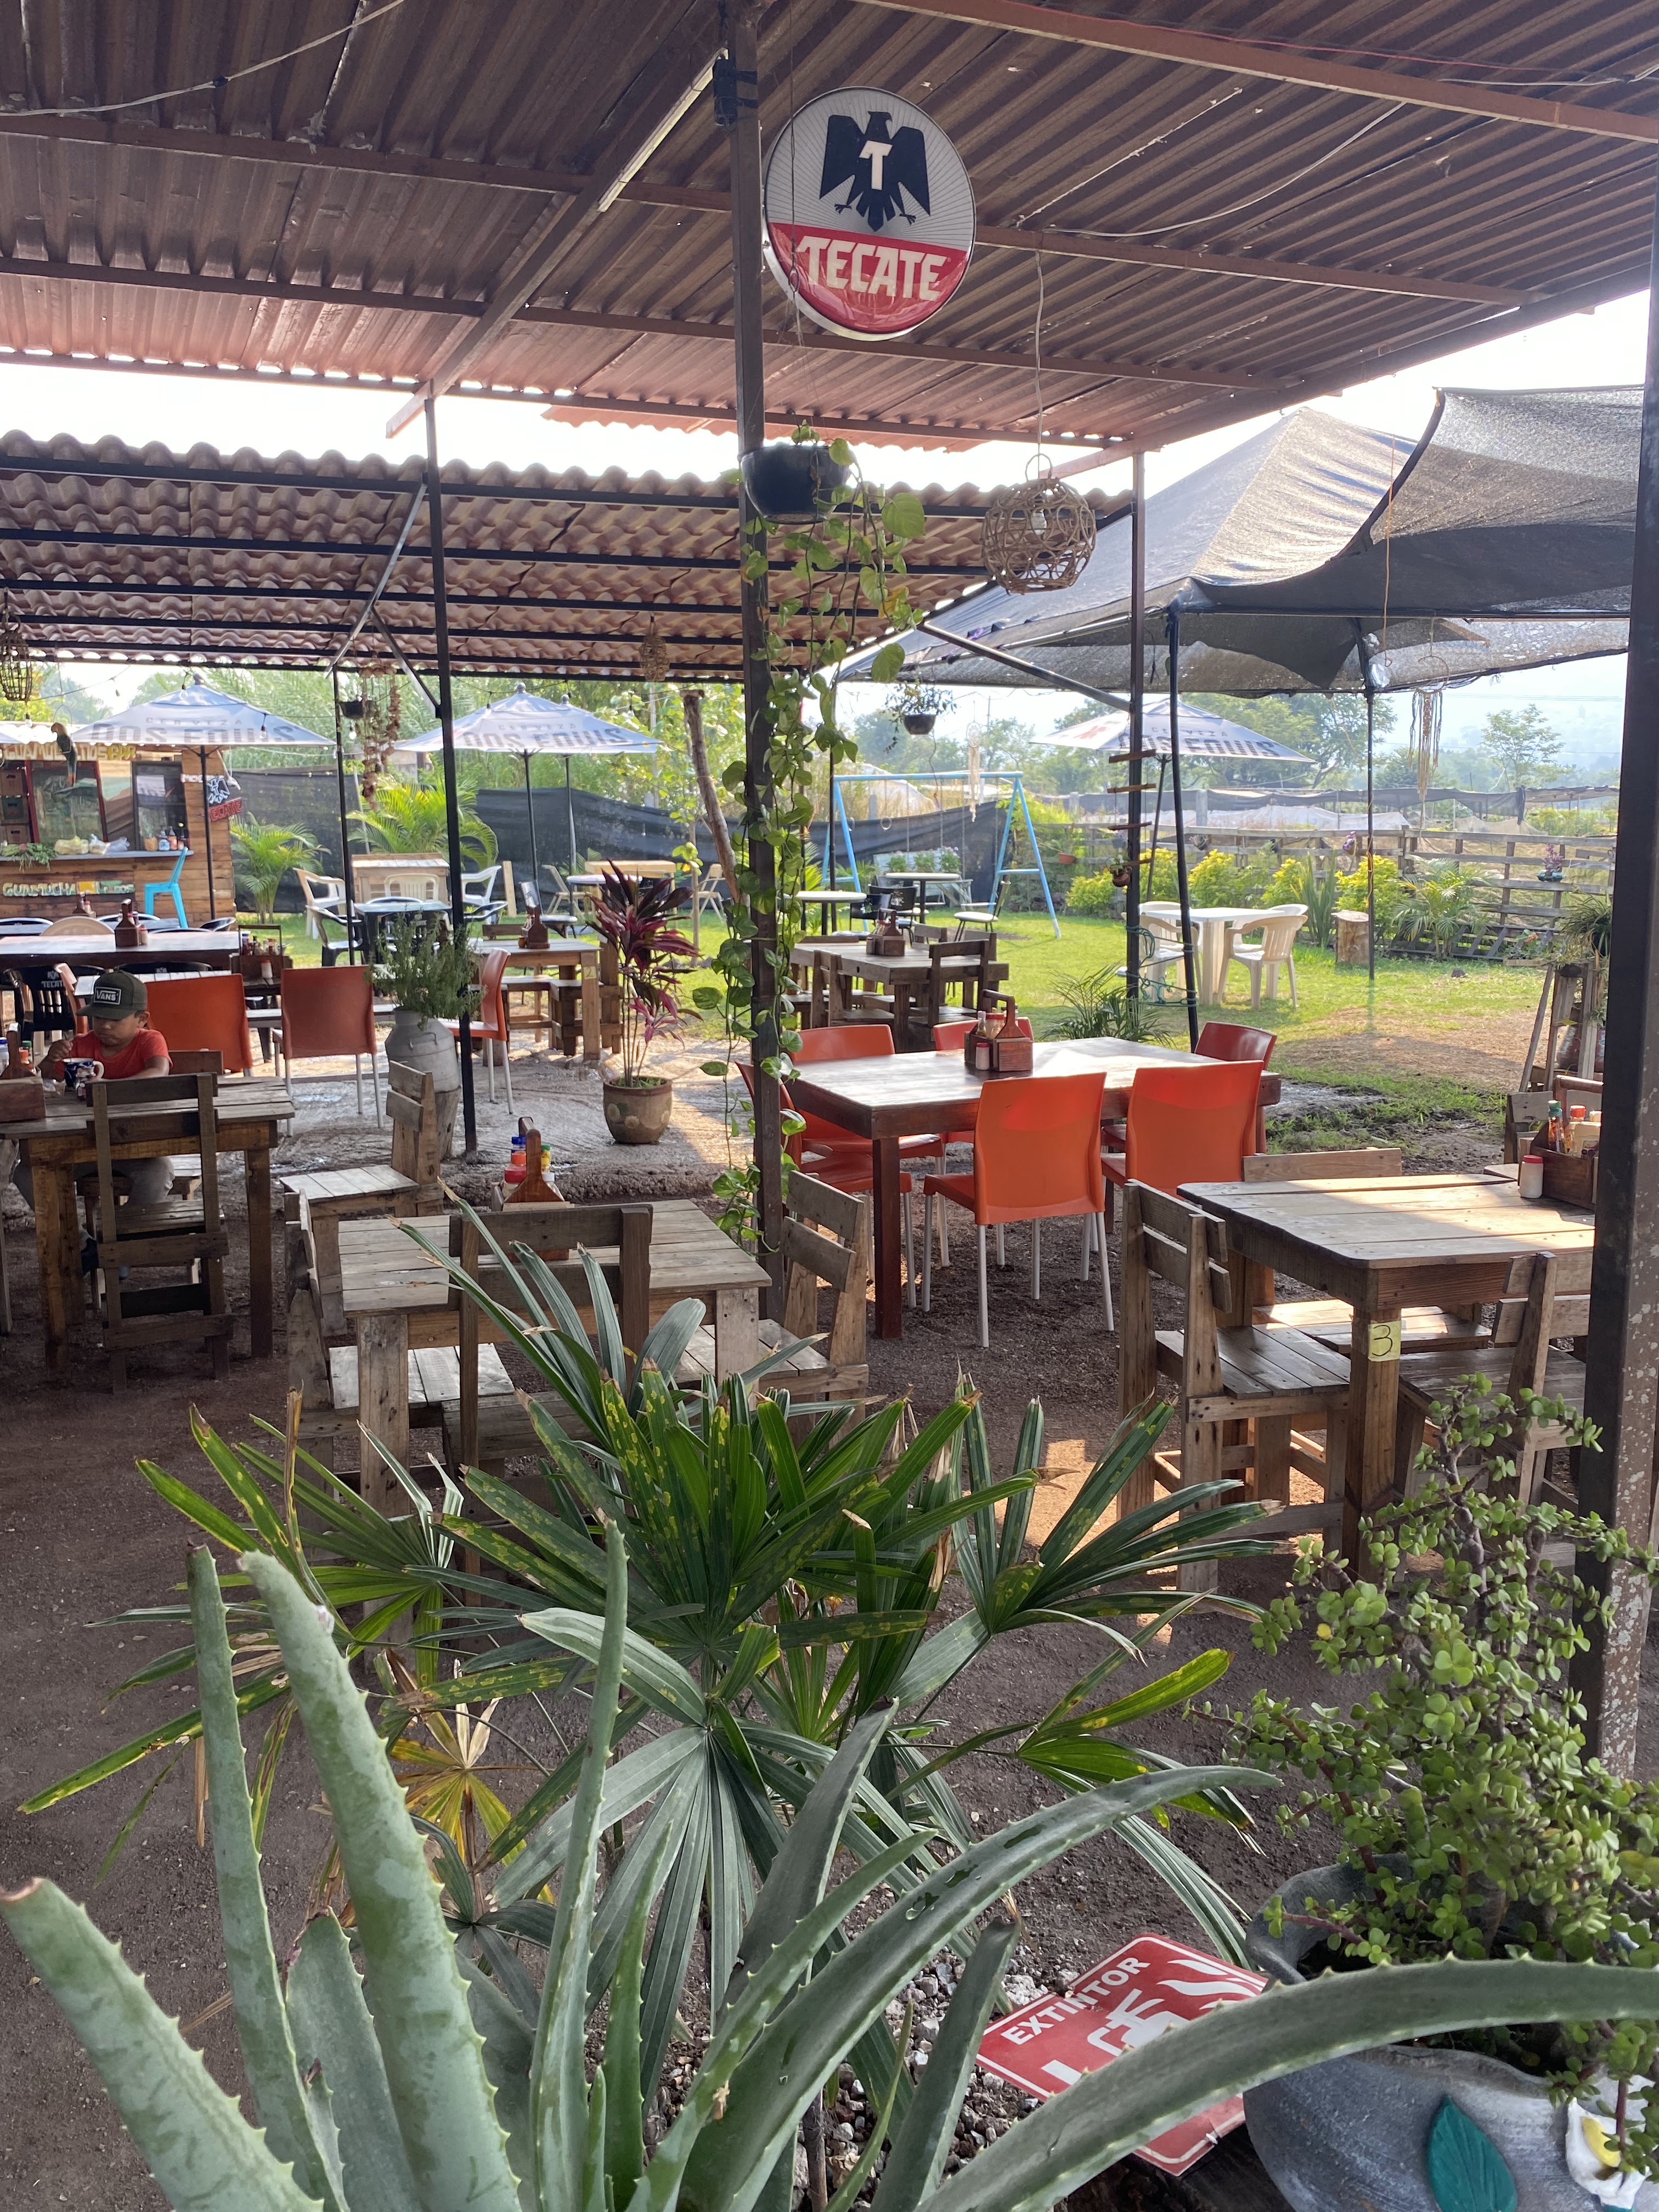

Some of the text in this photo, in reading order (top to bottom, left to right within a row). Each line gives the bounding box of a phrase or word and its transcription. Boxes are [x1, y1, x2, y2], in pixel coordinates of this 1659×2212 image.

[858, 140, 893, 190] T
[796, 235, 947, 301] TECATE
[1151, 727, 1228, 737] CEVEZA
[201, 797, 243, 823] ECATE
[41, 980, 63, 988] TECAT
[585, 967, 594, 978] 2
[97, 990, 117, 1001] VANS
[1372, 1324, 1393, 1356] 3
[1000, 1957, 1151, 2045] EXTINTOR
